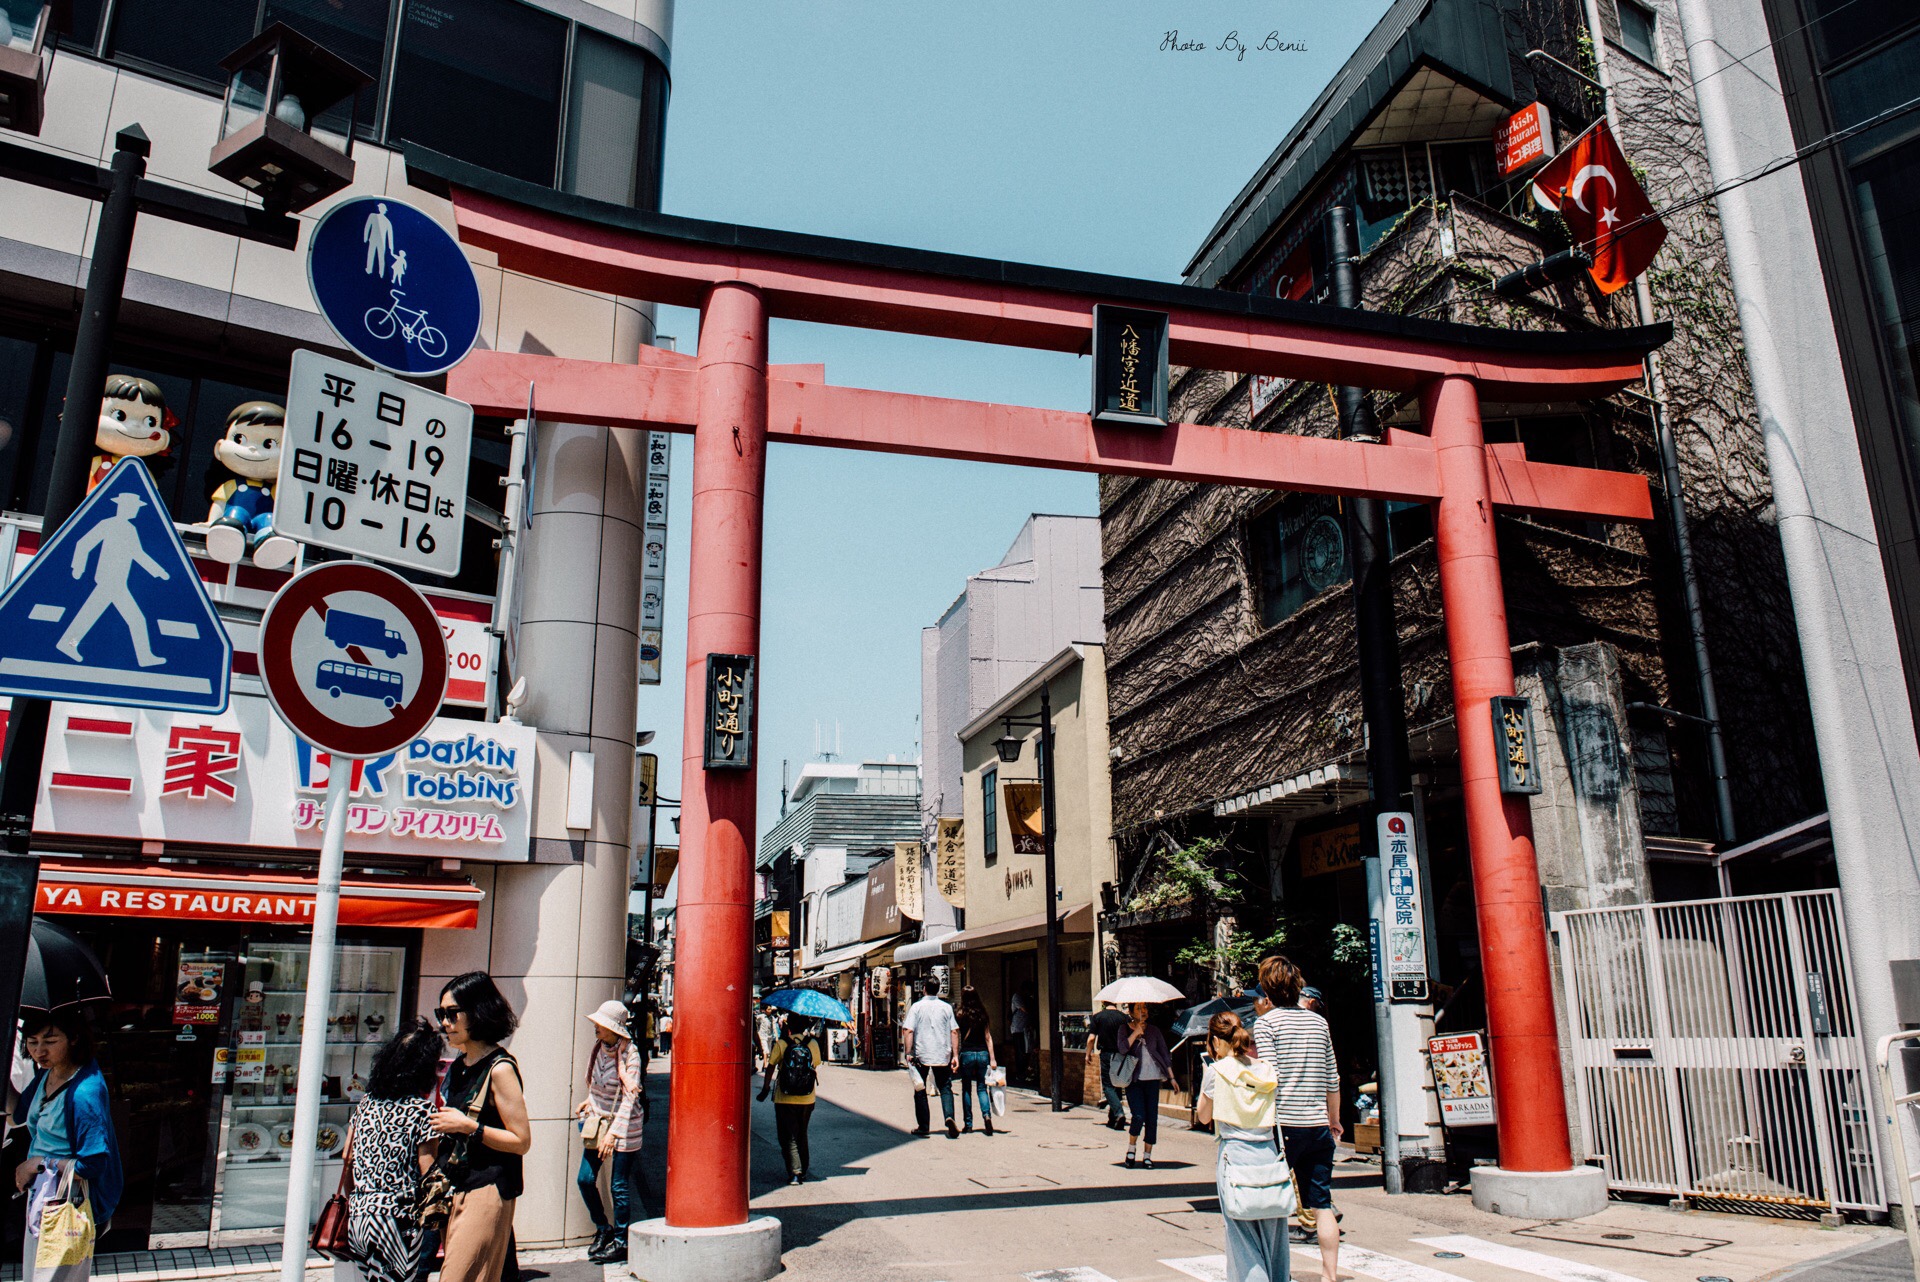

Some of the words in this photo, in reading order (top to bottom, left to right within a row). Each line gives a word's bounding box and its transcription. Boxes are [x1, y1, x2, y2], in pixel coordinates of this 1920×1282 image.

[1495, 121, 1539, 154] Restaurant
[1497, 112, 1534, 140] Turkish
[1497, 136, 1542, 173] トルコ料理
[1119, 324, 1140, 412] 八幡宮近道
[321, 373, 446, 439] 平日の
[715, 667, 744, 757] 小町通り
[1504, 707, 1530, 784] 小町通り
[397, 809, 503, 839] アイスクリーム
[943, 826, 958, 896] 鎌倉石道楽
[1391, 839, 1408, 868] 赤尾
[100, 890, 317, 917] RESTAURANT
[1396, 896, 1412, 925] 医院
[941, 968, 949, 994] 天然石
[1431, 1040, 1444, 1052] 3F
[1454, 1102, 1489, 1112] ARKADAS
